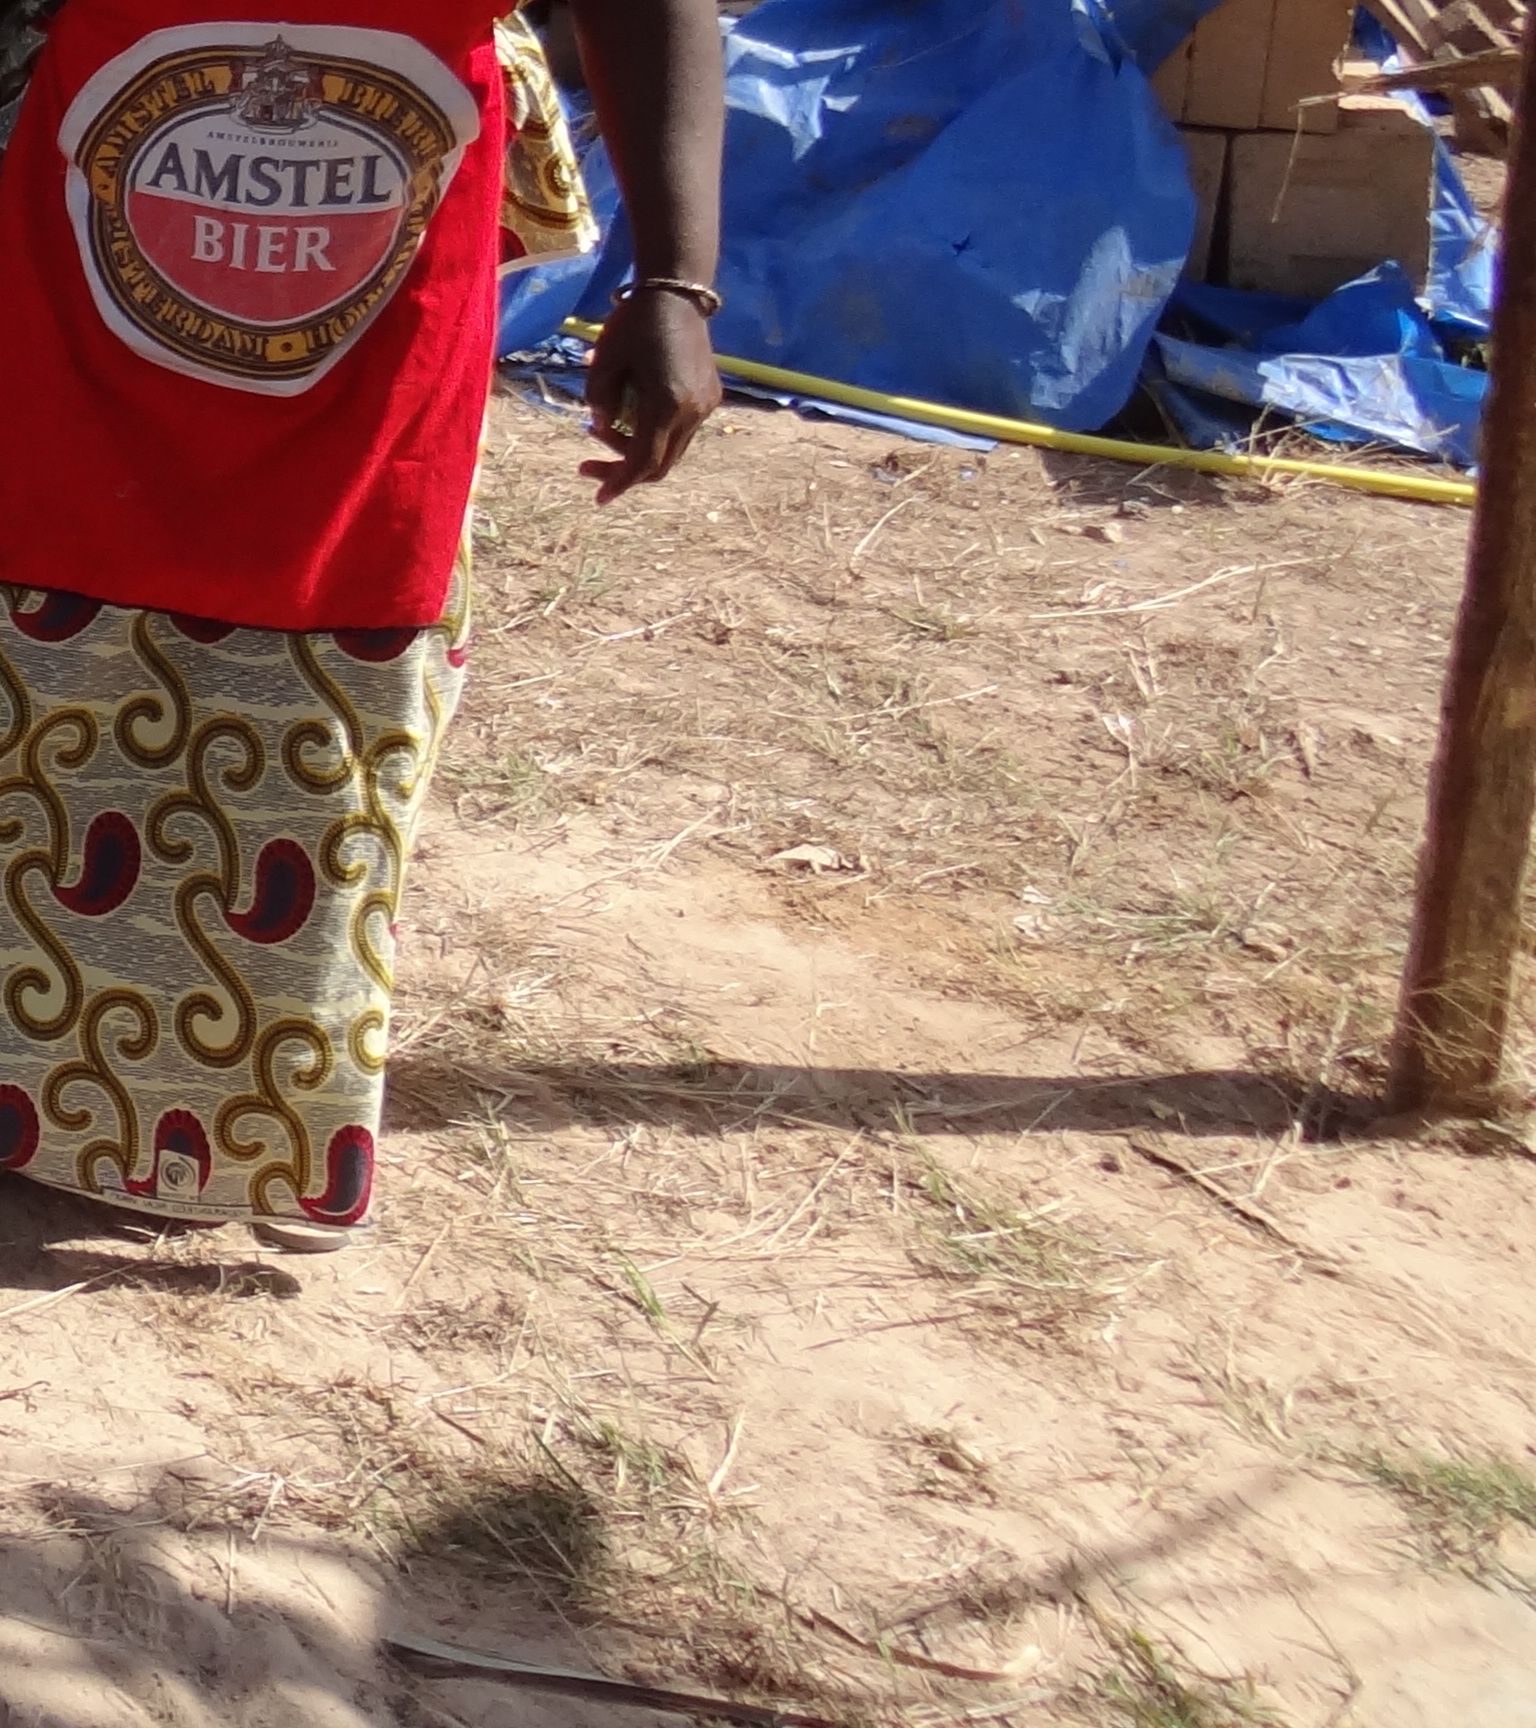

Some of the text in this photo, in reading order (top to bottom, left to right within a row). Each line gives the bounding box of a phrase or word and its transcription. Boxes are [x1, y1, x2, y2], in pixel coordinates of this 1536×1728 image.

[94, 70, 216, 176] AMSTEL
[145, 142, 394, 209] AMSTEL
[191, 215, 337, 273] BIER
